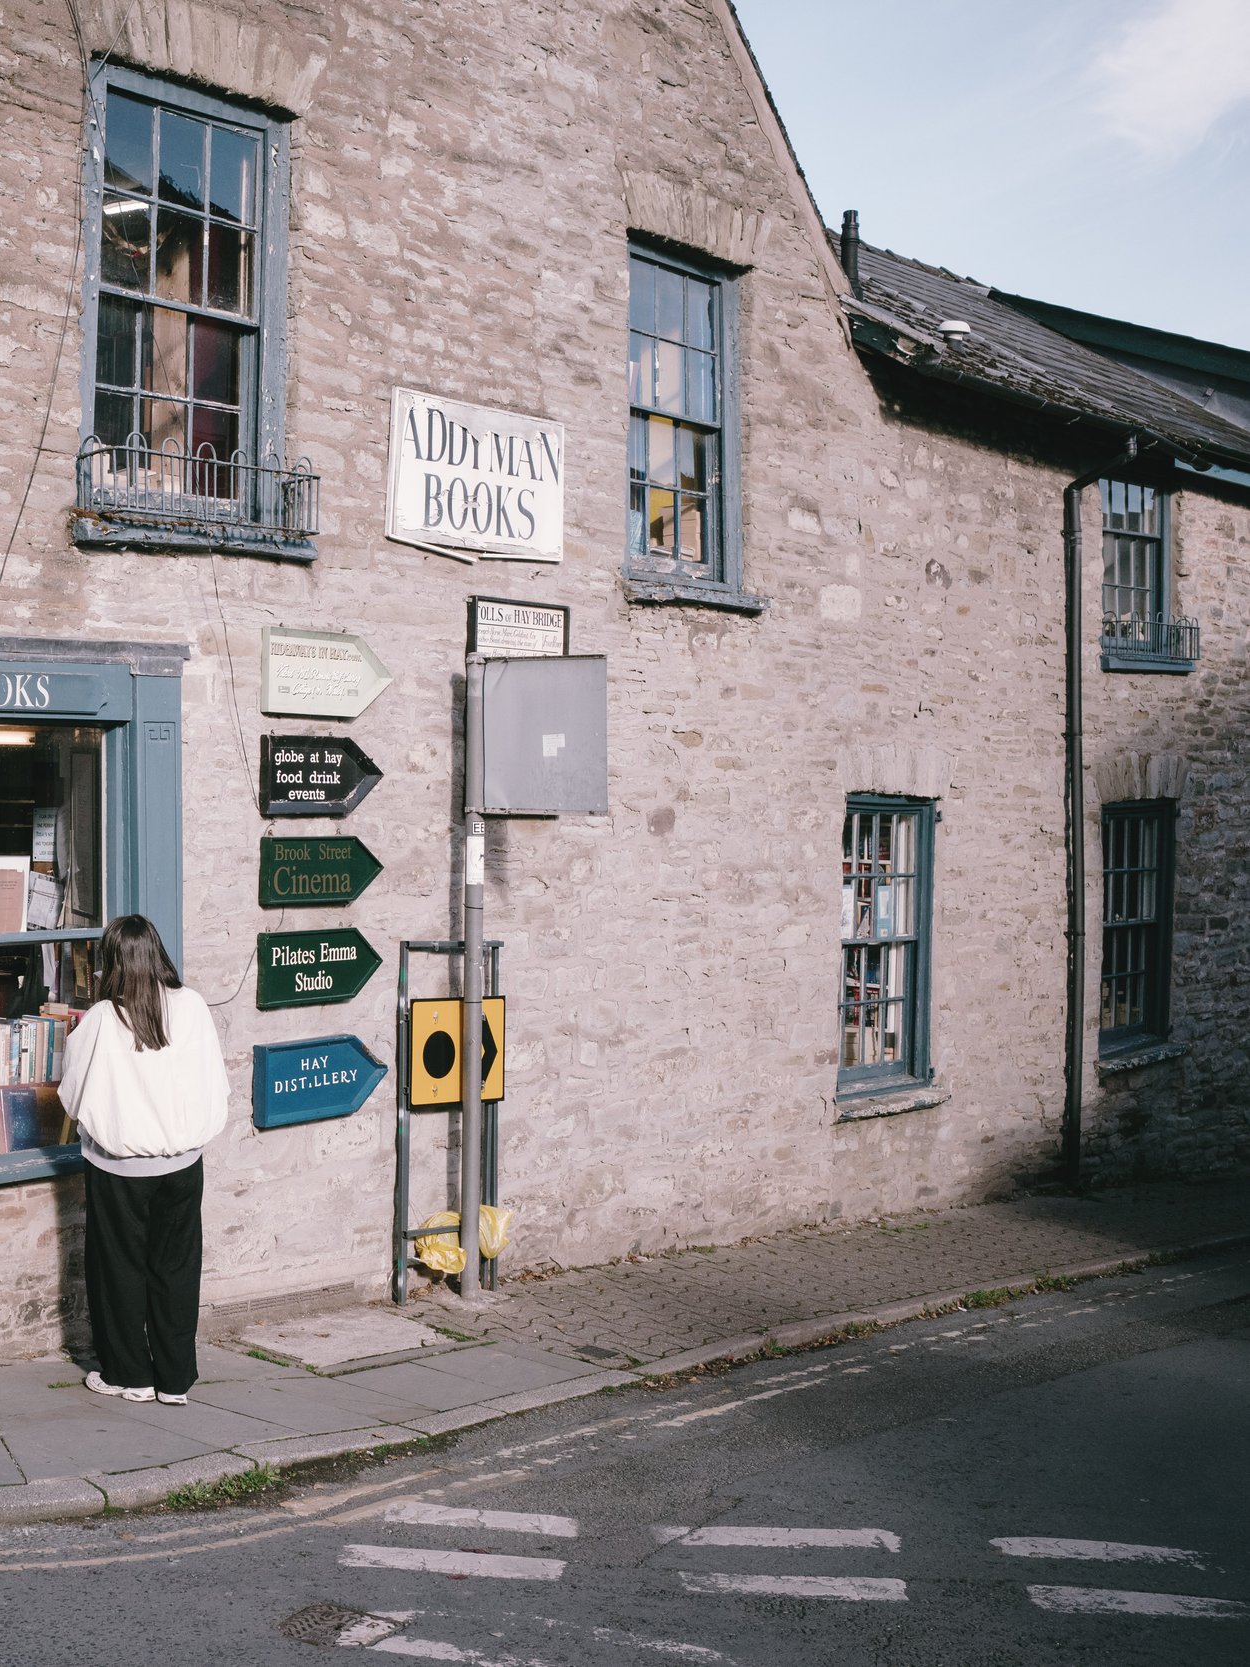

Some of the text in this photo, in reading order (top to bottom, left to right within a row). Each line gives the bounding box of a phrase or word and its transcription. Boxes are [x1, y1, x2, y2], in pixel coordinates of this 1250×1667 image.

[401, 406, 561, 486] ADDYMAN
[423, 472, 536, 541] BOOKS
[514, 609, 531, 625] HAY
[532, 611, 563, 629] BRIDGE
[274, 750, 343, 767] globe at hay
[276, 770, 341, 784] food drink
[288, 789, 326, 801] events
[274, 843, 352, 861] Brook Street
[273, 866, 351, 895] Cinema
[271, 942, 358, 967] Pilates Emma
[294, 971, 333, 992] Studio
[301, 1055, 329, 1071] HAY
